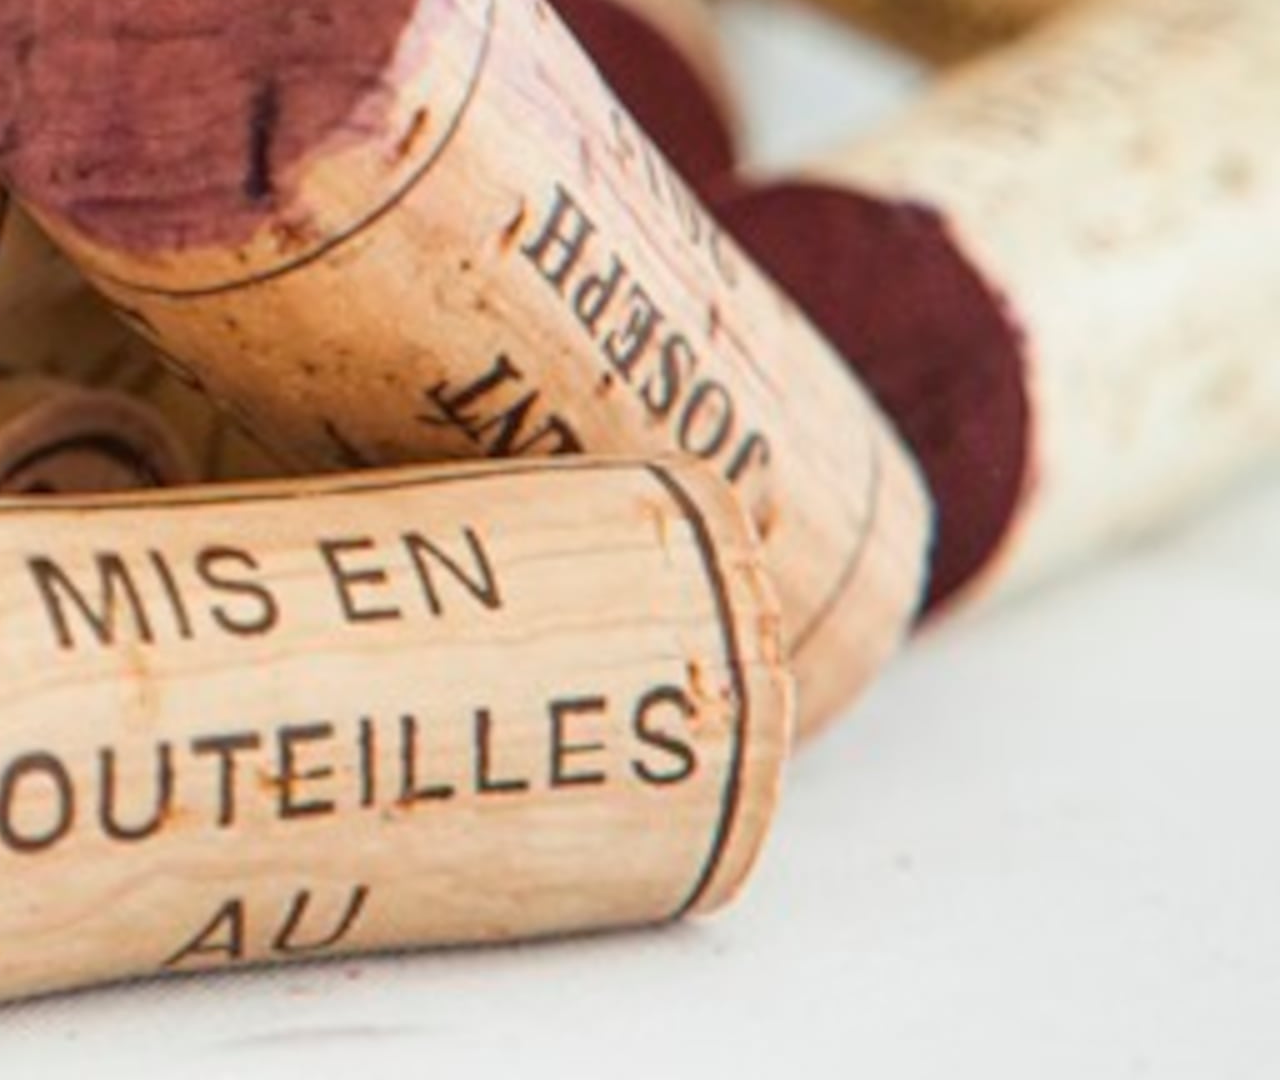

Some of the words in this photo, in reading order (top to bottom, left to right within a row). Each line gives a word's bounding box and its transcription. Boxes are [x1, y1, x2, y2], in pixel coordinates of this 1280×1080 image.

[520, 183, 771, 481] JOSEPH
[26, 545, 278, 649] MIS
[319, 526, 505, 623] EN
[164, 884, 368, 967] AU
